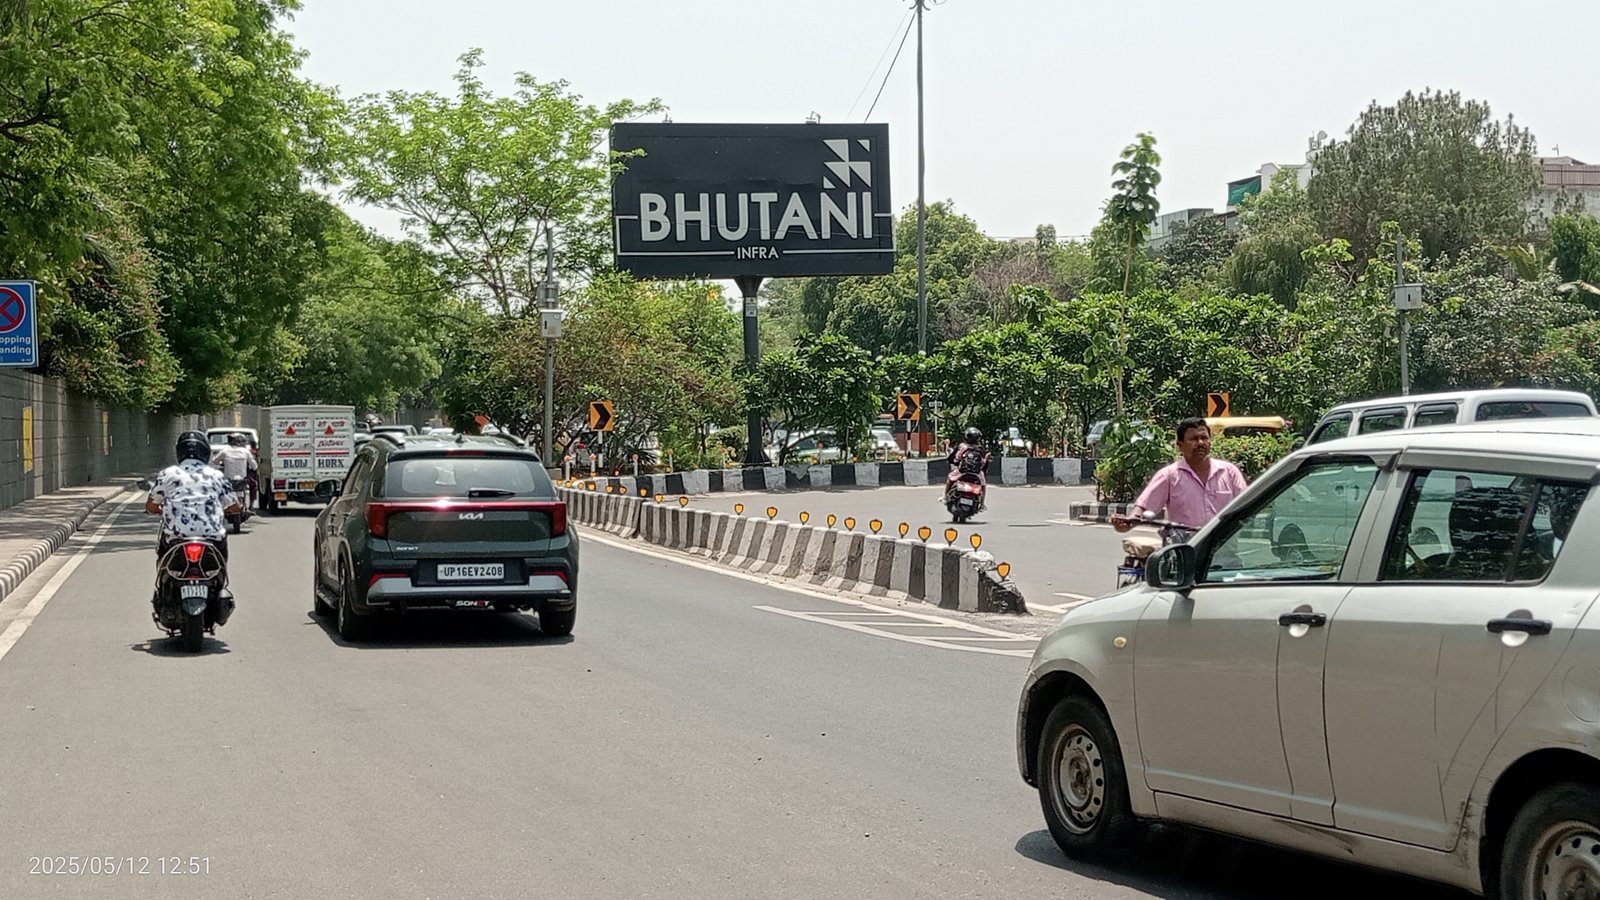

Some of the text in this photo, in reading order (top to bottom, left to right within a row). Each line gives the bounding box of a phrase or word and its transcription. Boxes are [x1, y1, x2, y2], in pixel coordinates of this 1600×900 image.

[639, 192, 873, 242] BHUTANI
[737, 246, 779, 260] INFRA
[458, 512, 484, 521] KIA
